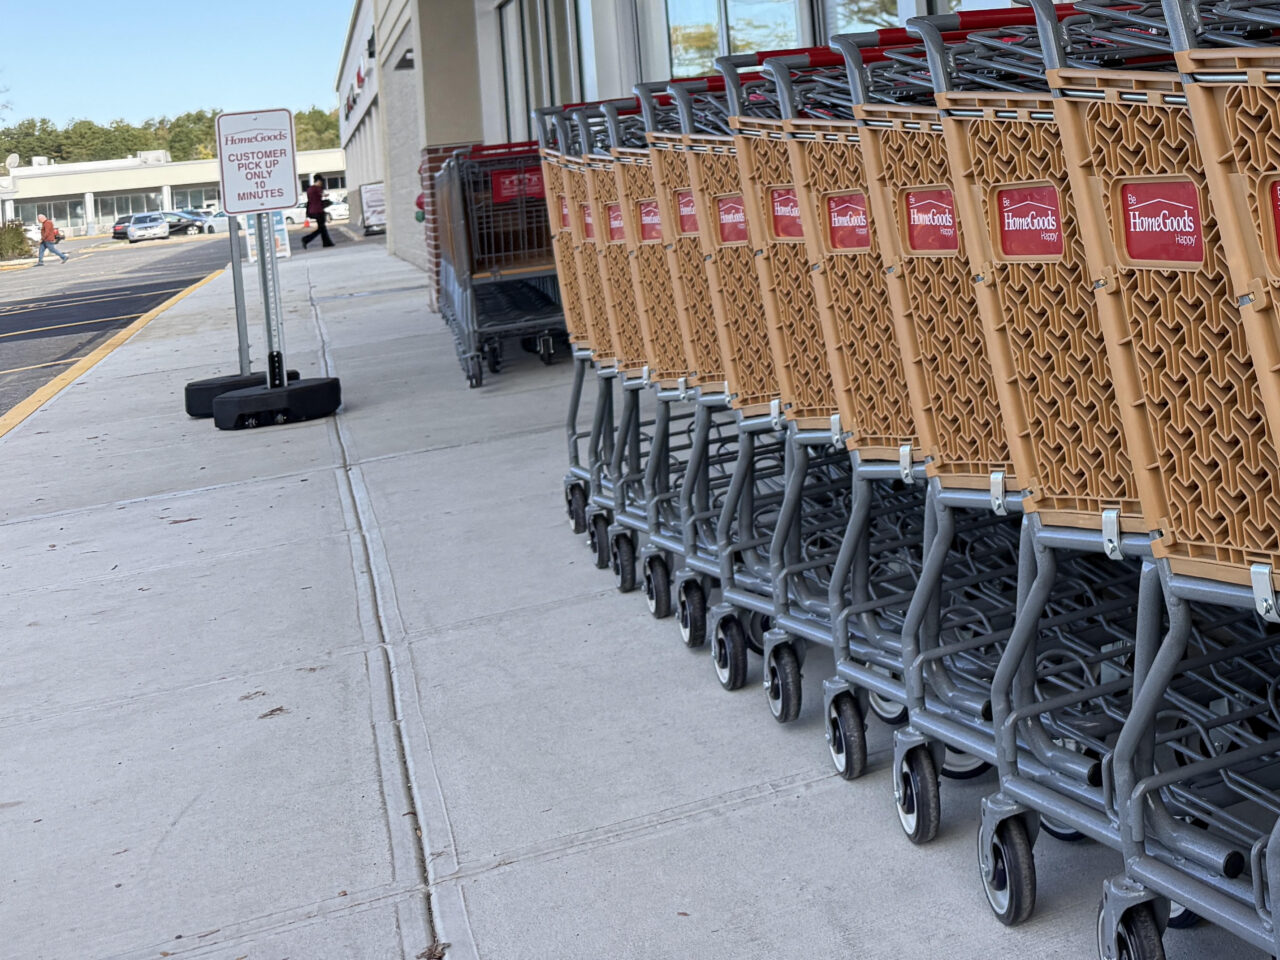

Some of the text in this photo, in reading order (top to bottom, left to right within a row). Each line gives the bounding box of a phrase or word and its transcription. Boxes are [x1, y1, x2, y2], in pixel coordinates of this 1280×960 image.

[224, 131, 288, 146] HomeGoods
[228, 149, 287, 162] CUSTOMER
[237, 159, 279, 172] PICK UP
[245, 170, 273, 181] ONLY
[254, 180, 266, 189] 10
[237, 188, 285, 201] MINUTES
[1003, 210, 1057, 231] HomeGoods
[1128, 209, 1195, 232] HomeGoods
